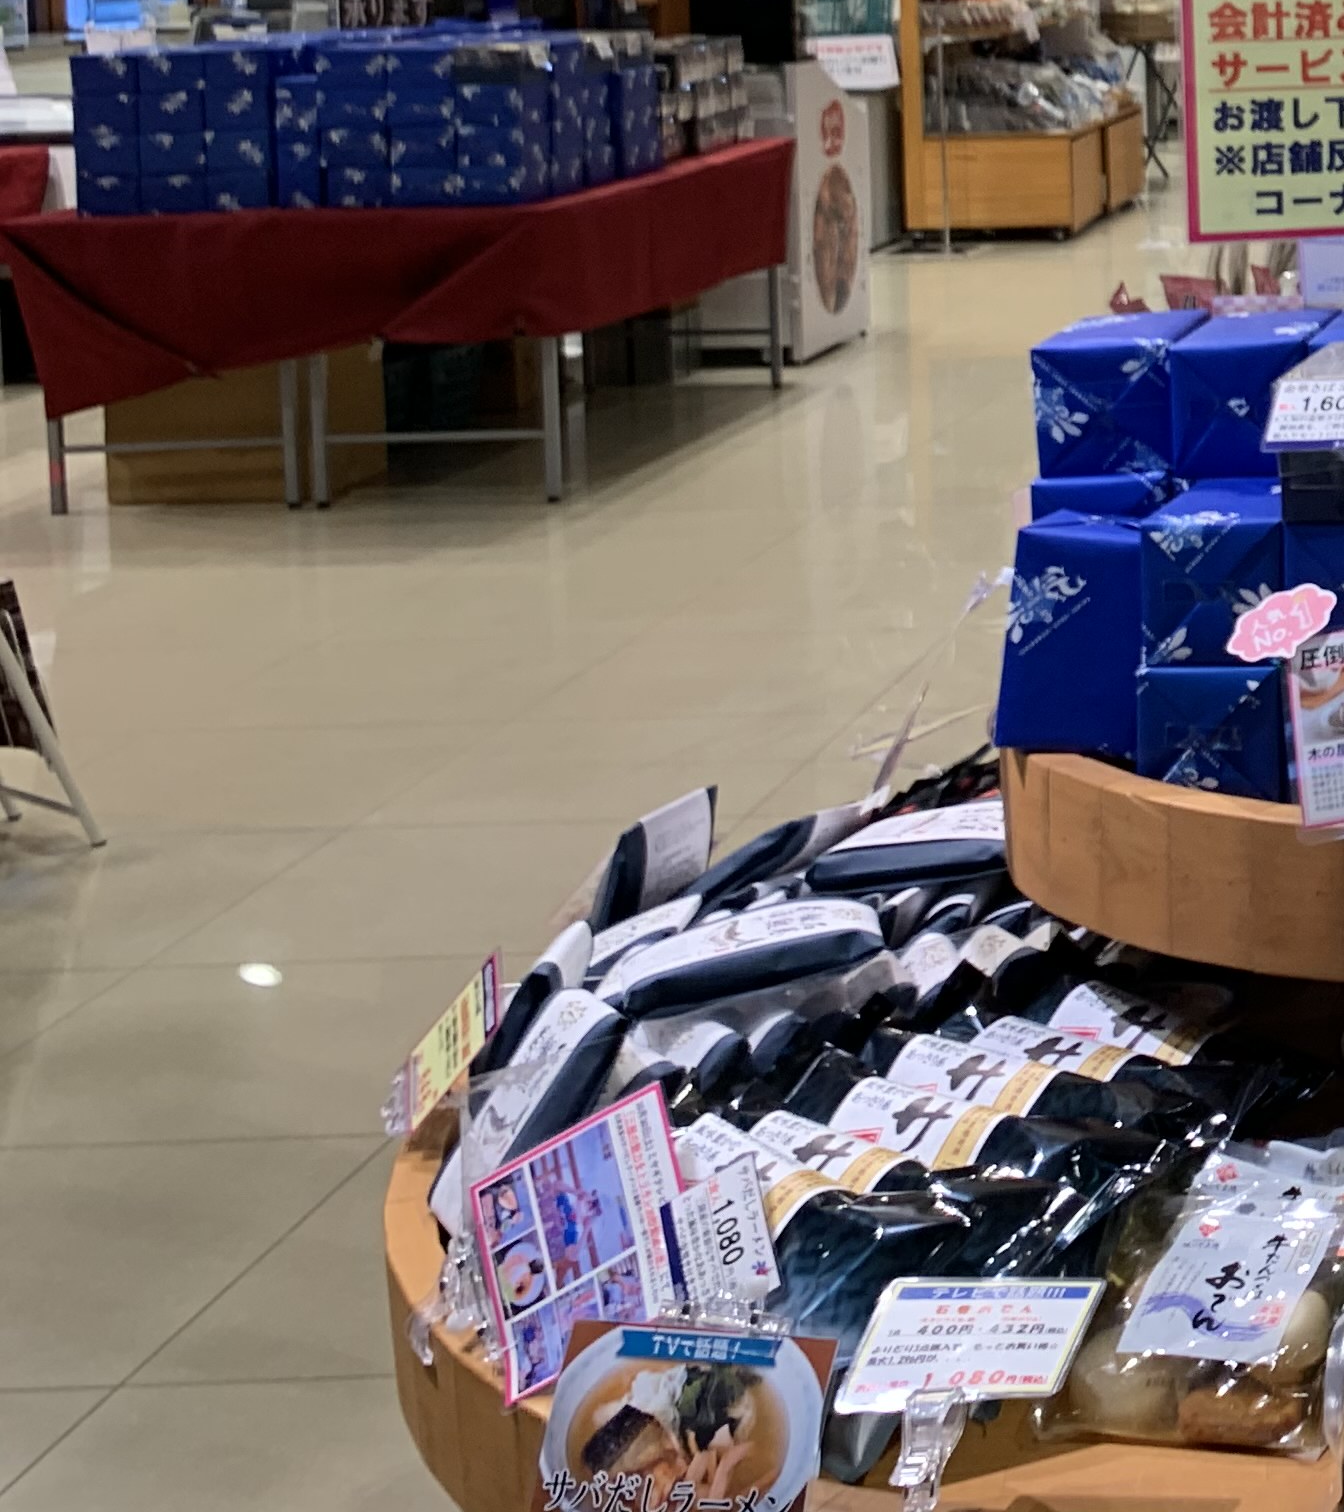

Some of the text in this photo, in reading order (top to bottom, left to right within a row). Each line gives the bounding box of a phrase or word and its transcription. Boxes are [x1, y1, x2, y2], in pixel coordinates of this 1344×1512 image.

[712, 1198, 745, 1266] 1,080
[1191, 1261, 1247, 1332] おでん
[543, 1469, 796, 1512] サバだしラーメン
